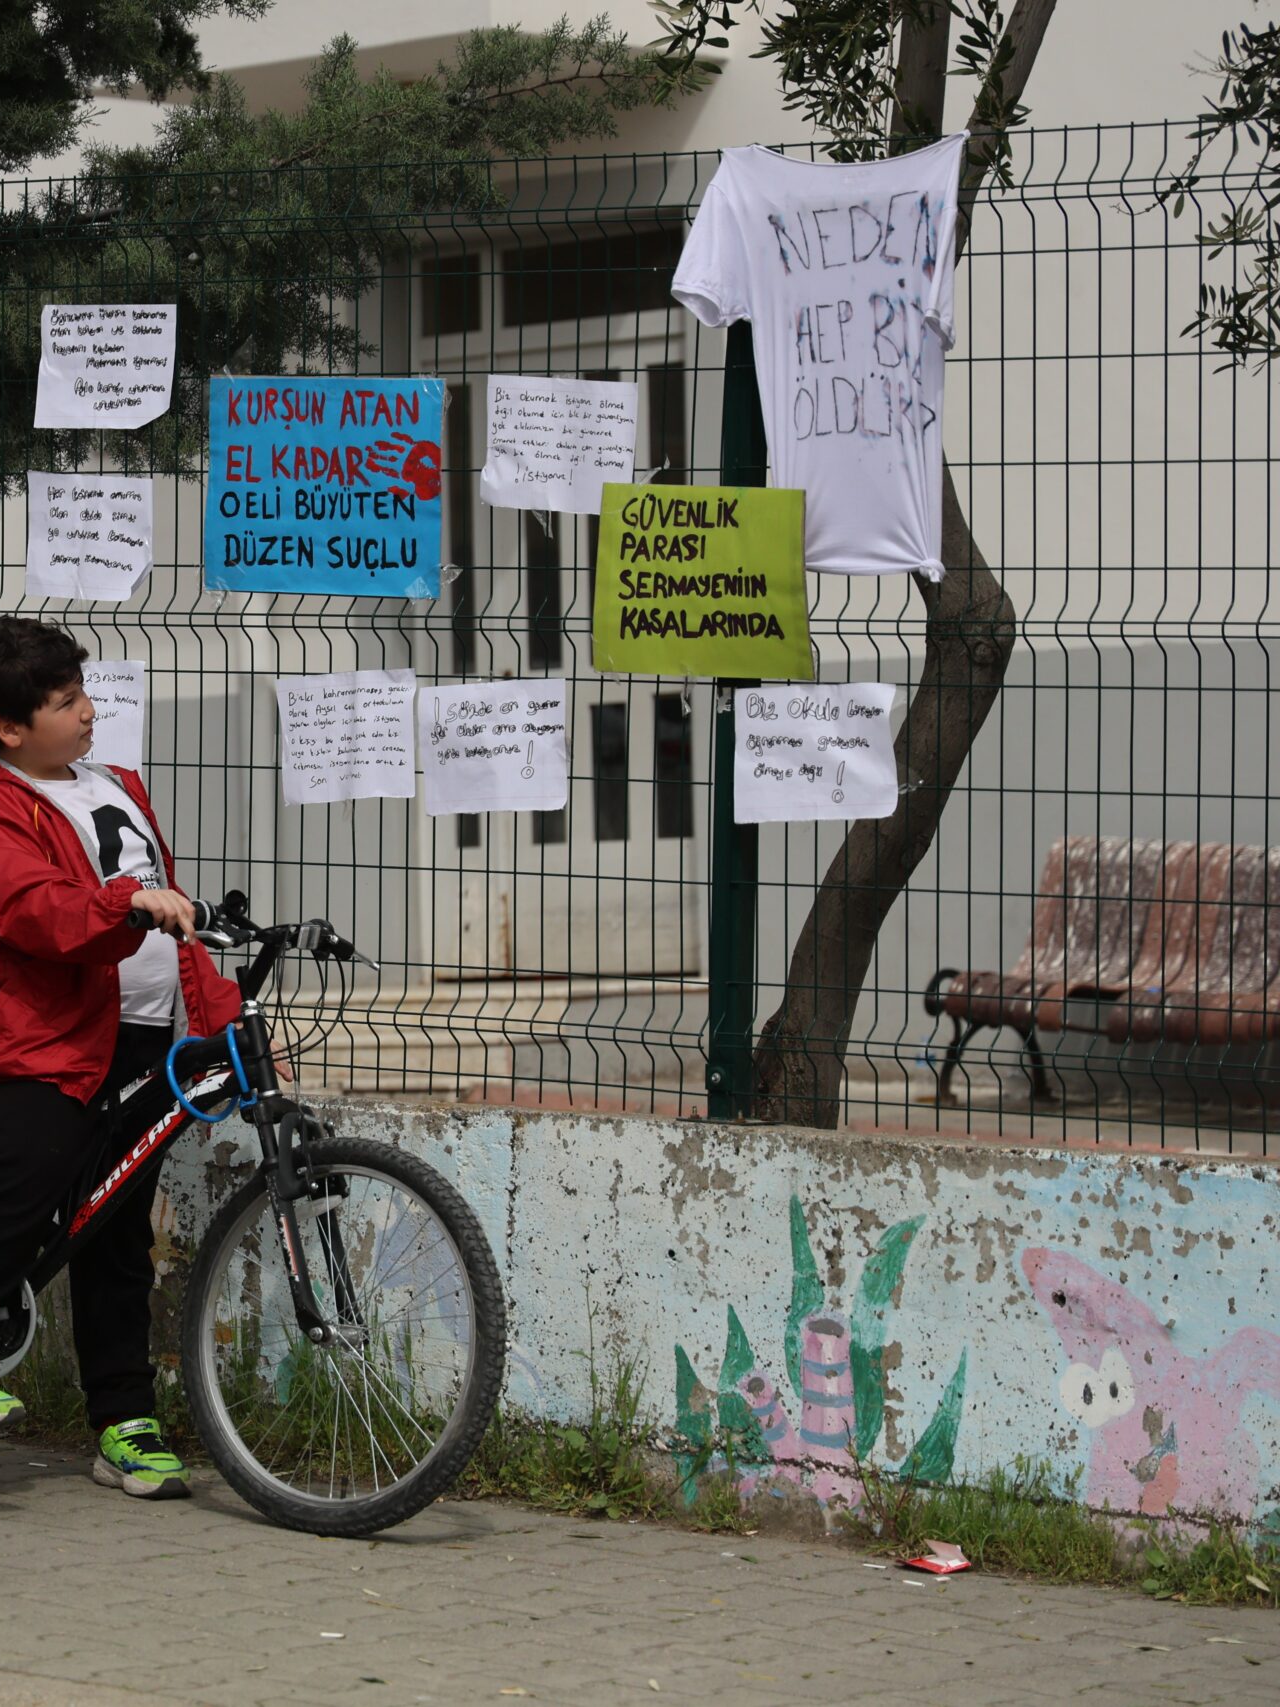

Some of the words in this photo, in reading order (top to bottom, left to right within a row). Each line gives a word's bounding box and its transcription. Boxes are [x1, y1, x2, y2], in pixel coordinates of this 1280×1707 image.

[794, 299, 853, 367] HEP
[227, 388, 326, 430] KURŞUN
[340, 390, 419, 430] ATAN
[495, 387, 511, 403] Biz
[226, 445, 262, 483] EL
[272, 444, 372, 487] KADAR
[295, 484, 416, 521] BÜYÜTEN
[622, 493, 739, 531] GÜVENLİK
[224, 530, 314, 568] DÜZEN
[327, 535, 417, 577] SUÇLU
[620, 532, 705, 563] PARASI
[620, 605, 785, 640] KASALARINDA
[445, 700, 493, 725] Sözde
[499, 700, 519, 714] en
[746, 692, 779, 721] Biz
